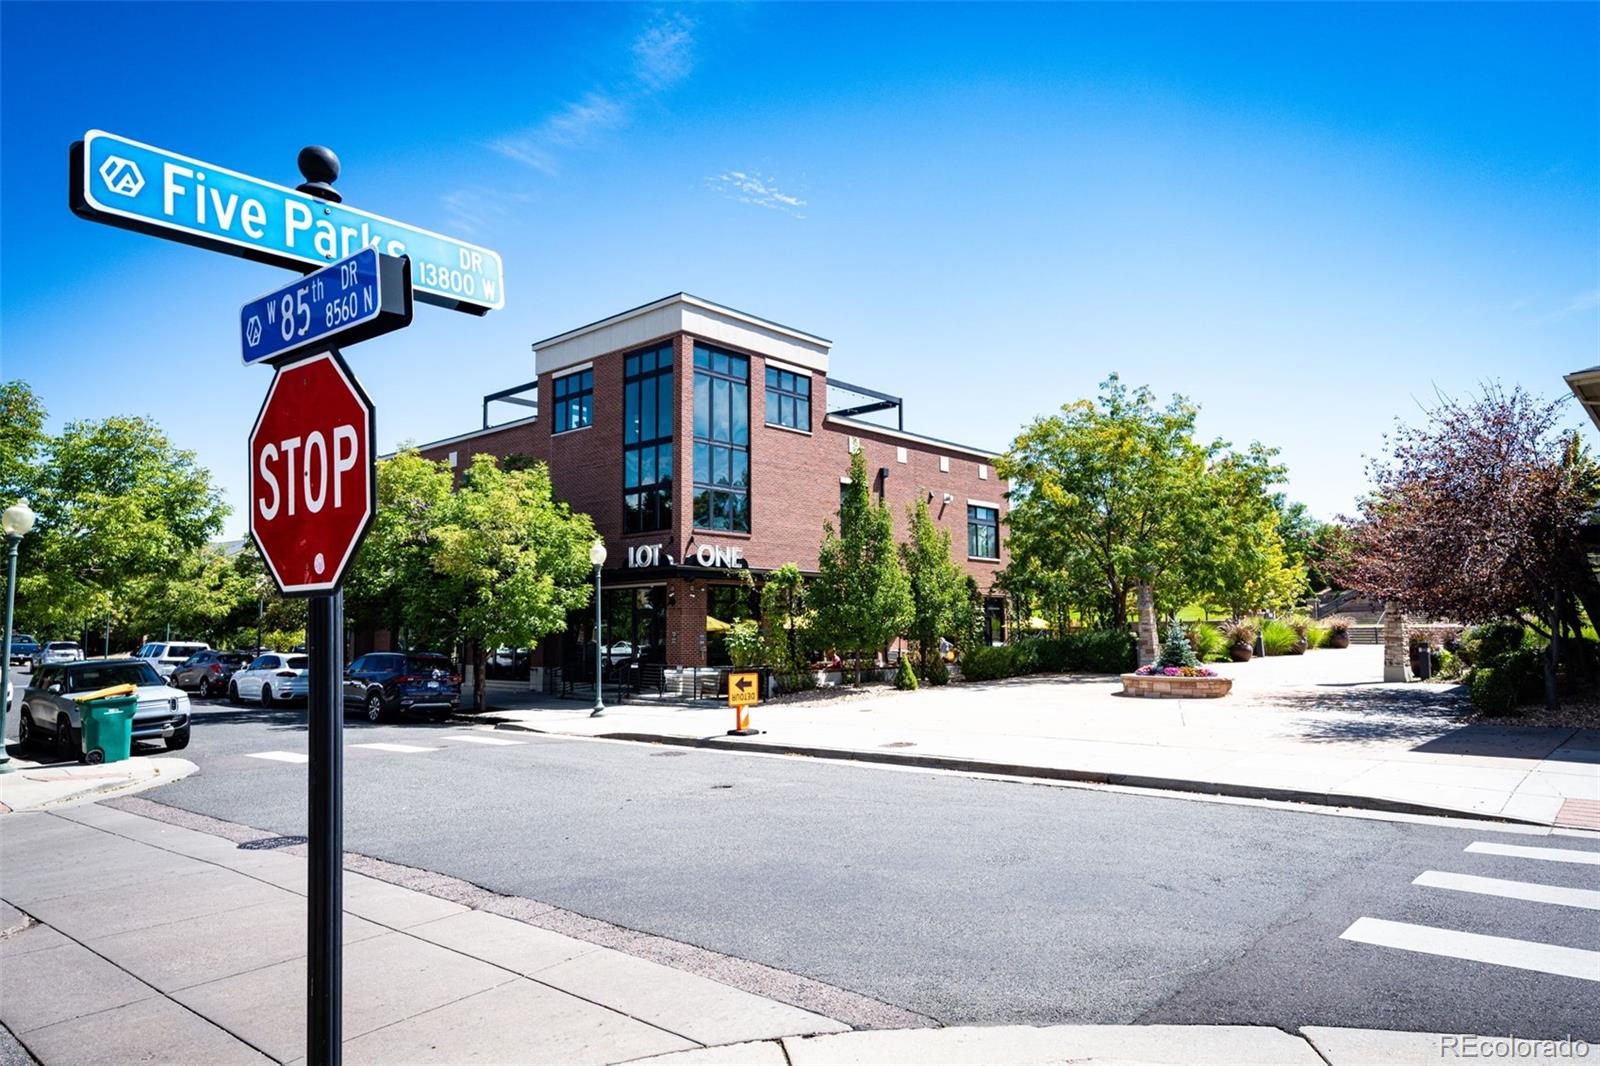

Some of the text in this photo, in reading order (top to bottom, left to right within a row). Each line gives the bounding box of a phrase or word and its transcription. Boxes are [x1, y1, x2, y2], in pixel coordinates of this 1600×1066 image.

[163, 161, 267, 239] Five
[460, 248, 483, 275] DR
[266, 261, 359, 341] W 85th DR
[419, 261, 496, 301] 13800 W
[325, 284, 373, 328] 8560 N
[259, 424, 359, 521] STOP
[628, 543, 744, 568] LOT ONE
[731, 691, 756, 702] DETOUR
